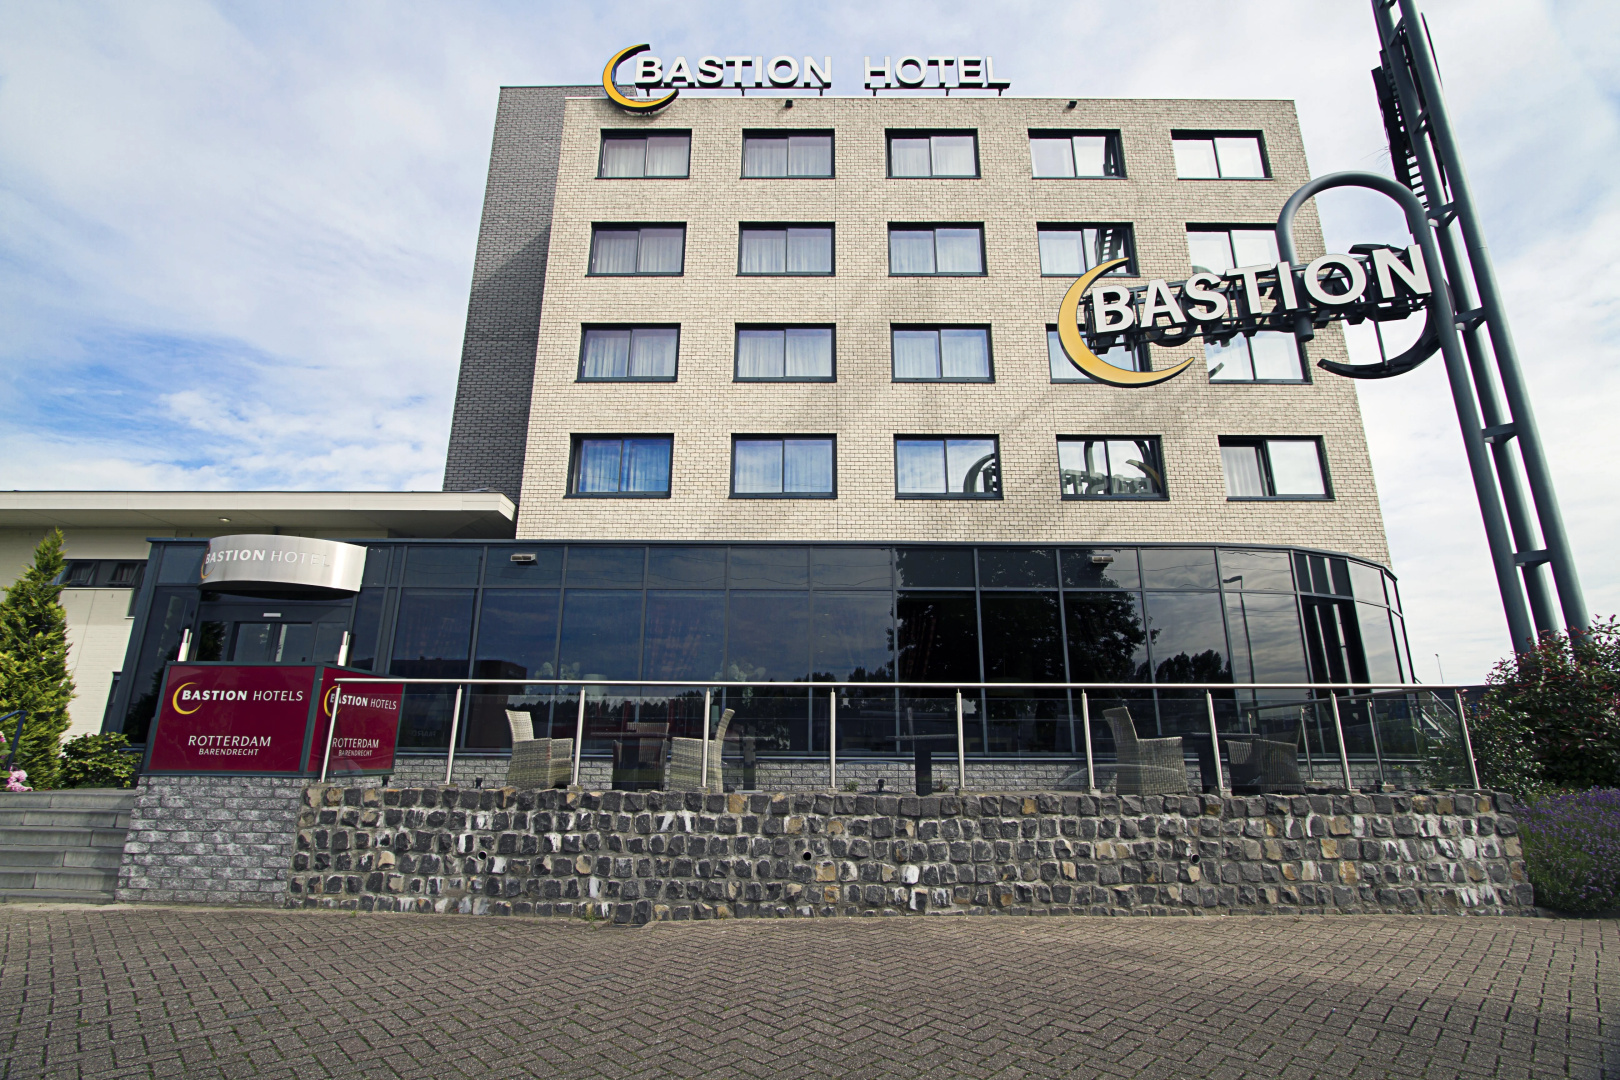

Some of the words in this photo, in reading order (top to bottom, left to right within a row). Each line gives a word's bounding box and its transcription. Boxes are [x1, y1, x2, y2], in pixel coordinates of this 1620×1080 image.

[634, 55, 832, 88] BASTION
[864, 55, 1011, 88] HOTEL
[1091, 244, 1432, 334] BASTION
[205, 549, 266, 564] BASTION
[270, 550, 330, 567] HOTEL
[181, 690, 247, 701] BASTION
[253, 690, 304, 702] HOTELS
[370, 698, 397, 710] HOTELS
[188, 735, 272, 747] ROTTERDAM
[332, 737, 380, 748] ROTTERDAM
[198, 748, 259, 756] BARENDRECHT
[338, 749, 373, 757] BARENDRECHT
